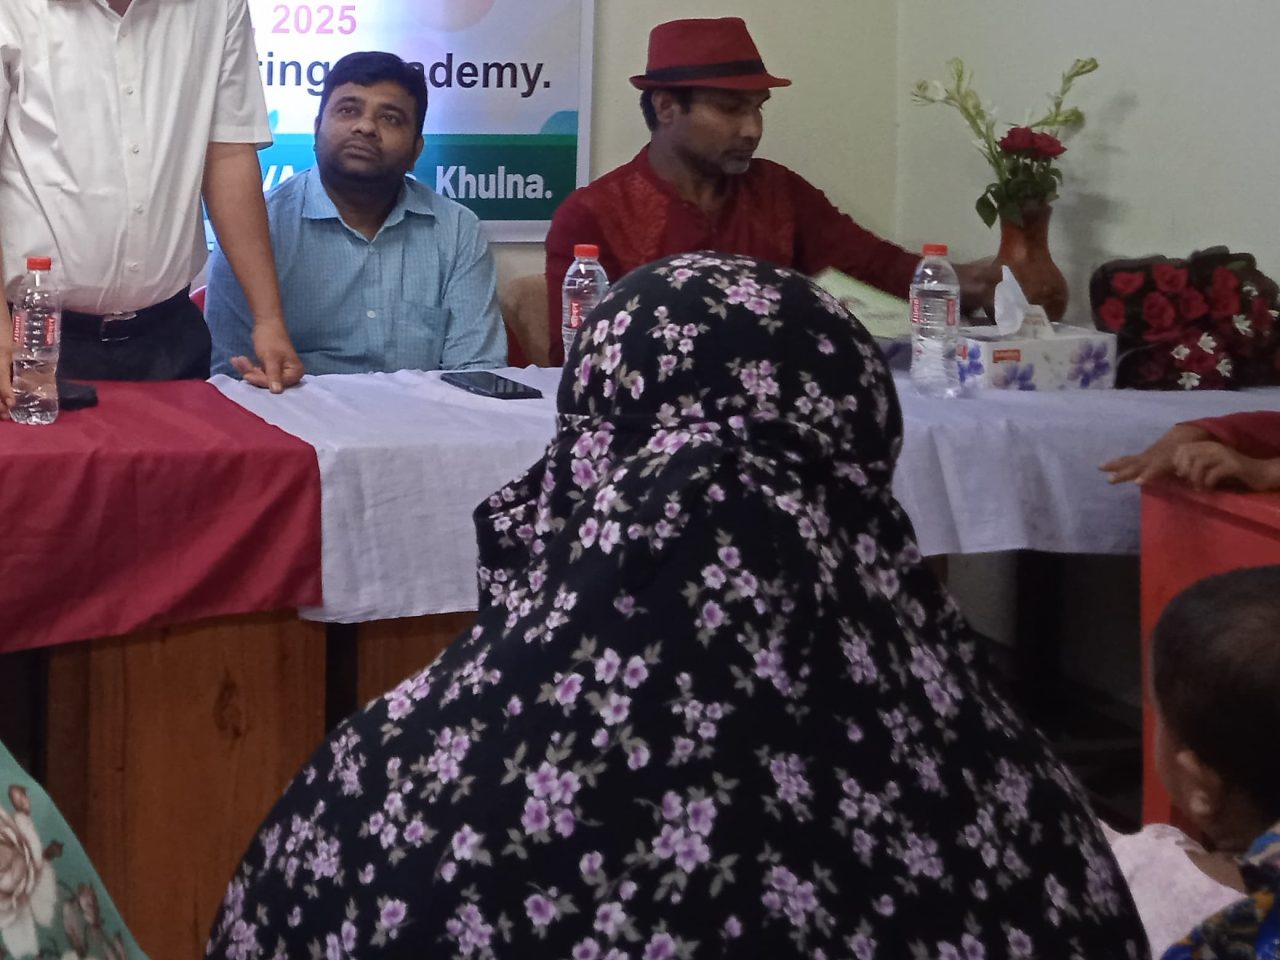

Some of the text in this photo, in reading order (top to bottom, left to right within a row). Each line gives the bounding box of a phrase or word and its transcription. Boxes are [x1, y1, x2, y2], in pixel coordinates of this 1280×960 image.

[272, 4, 358, 35] 2025
[258, 52, 329, 96] ing
[435, 165, 553, 201] Khulna.
